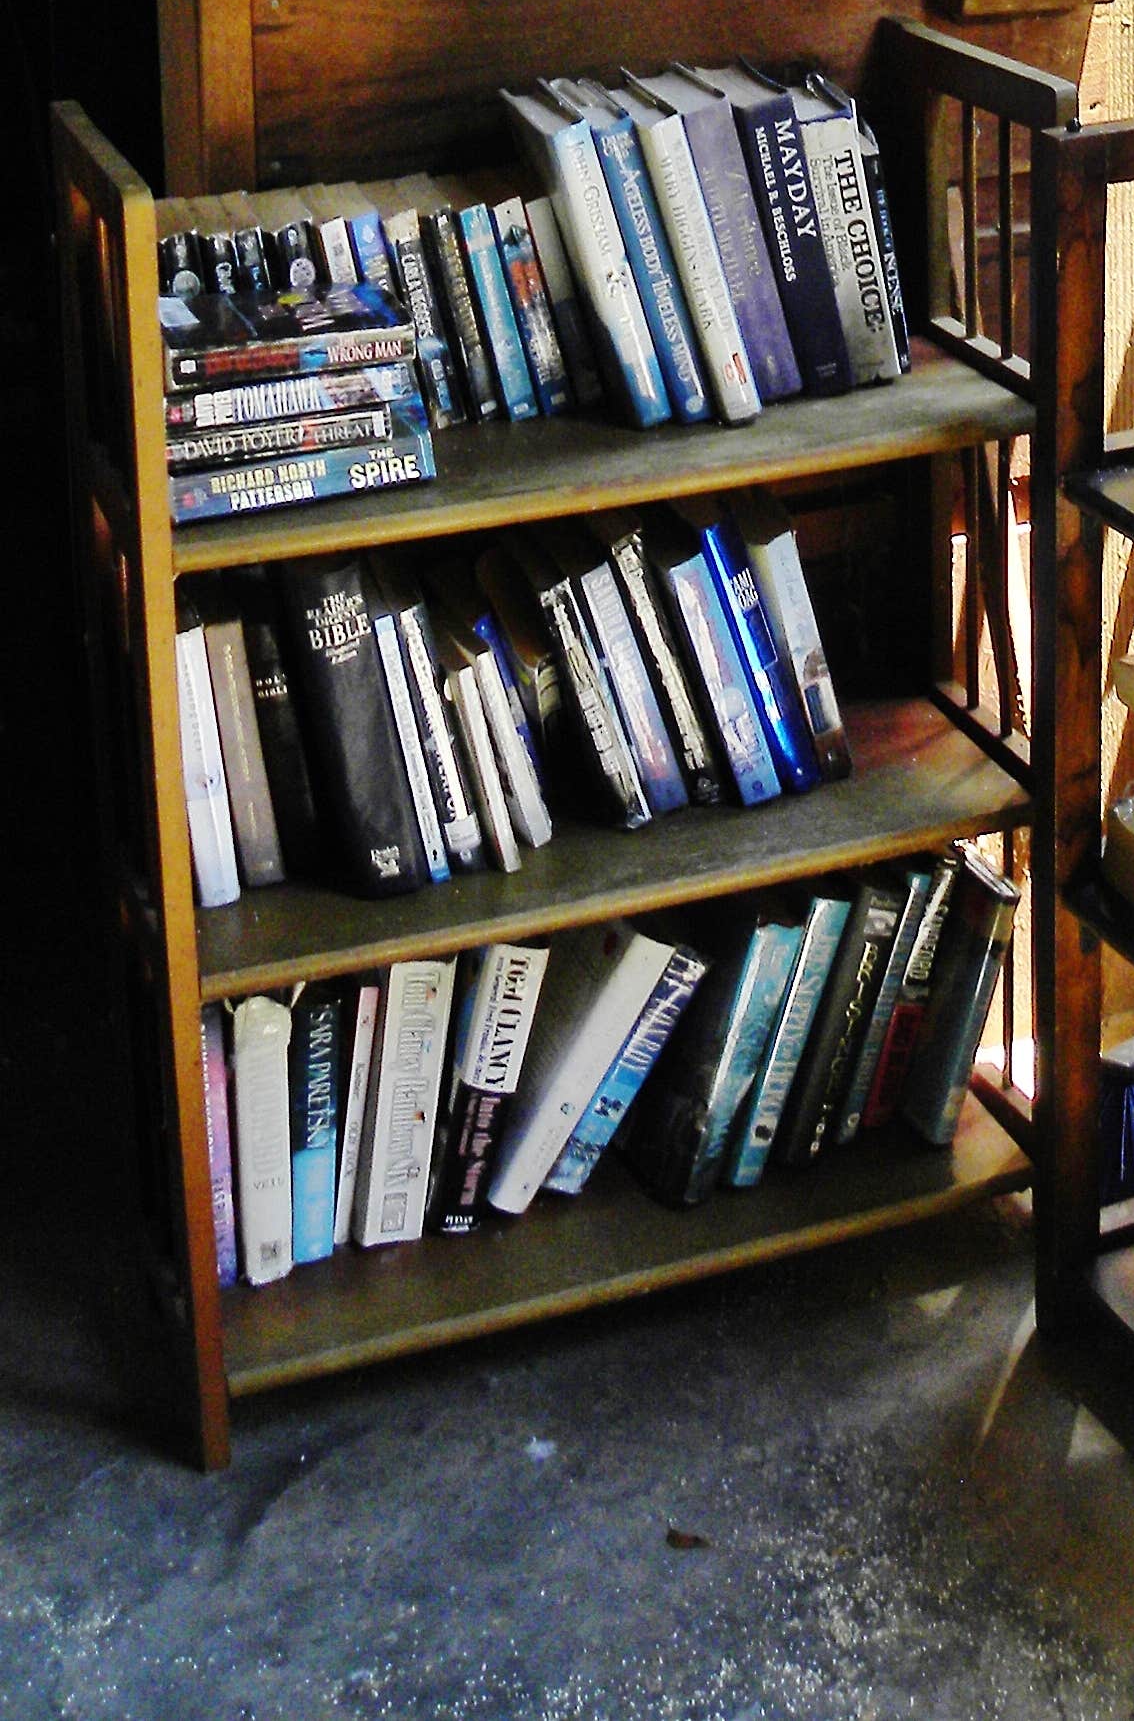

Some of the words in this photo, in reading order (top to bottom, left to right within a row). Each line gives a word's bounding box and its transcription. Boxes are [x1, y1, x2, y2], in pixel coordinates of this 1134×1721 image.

[755, 126, 776, 190] MICHAEL
[773, 118, 818, 239] MAYDAY
[823, 155, 835, 176] The
[567, 140, 592, 184] JOHN
[582, 183, 613, 256] GRISHAM
[769, 191, 779, 205] R.
[809, 158, 826, 210] Survival
[820, 215, 830, 231] in
[825, 178, 838, 210] Issue
[834, 149, 861, 214] THE
[619, 169, 656, 241] AGELESS
[639, 236, 665, 279] BODY
[659, 155, 678, 200] MARY
[672, 200, 697, 270] HIGGINS
[692, 277, 713, 332] CLARK
[832, 215, 842, 231] of
[771, 206, 798, 283] BESCHLOSS
[833, 234, 851, 272] Black
[847, 217, 886, 335] CHOICE:
[328, 340, 373, 363] WRONG
[372, 338, 403, 357] MAN
[183, 436, 235, 459] DAVID
[242, 427, 300, 453] POYER
[369, 447, 395, 459] THE
[210, 468, 276, 495] RICHARD
[278, 459, 327, 486] NORTH
[349, 454, 421, 489] SPIRE
[230, 480, 314, 510] PATTERSON
[306, 593, 363, 619] READER'S
[315, 610, 357, 627] DIGEST
[323, 591, 346, 606] THE
[587, 571, 629, 638] SANDRA
[309, 613, 372, 650] BIBLE
[401, 969, 440, 1010] Tom
[501, 955, 531, 1003] TOM
[307, 1010, 333, 1060] SARA
[391, 1011, 434, 1074] Clancy
[484, 1004, 521, 1089] CLANCY
[620, 997, 680, 1074] CONROY
[304, 1062, 334, 1148] PARETSKY
[386, 1075, 429, 1157] Rainbow
[476, 1095, 501, 1130] Into
[383, 1157, 419, 1189] Six
